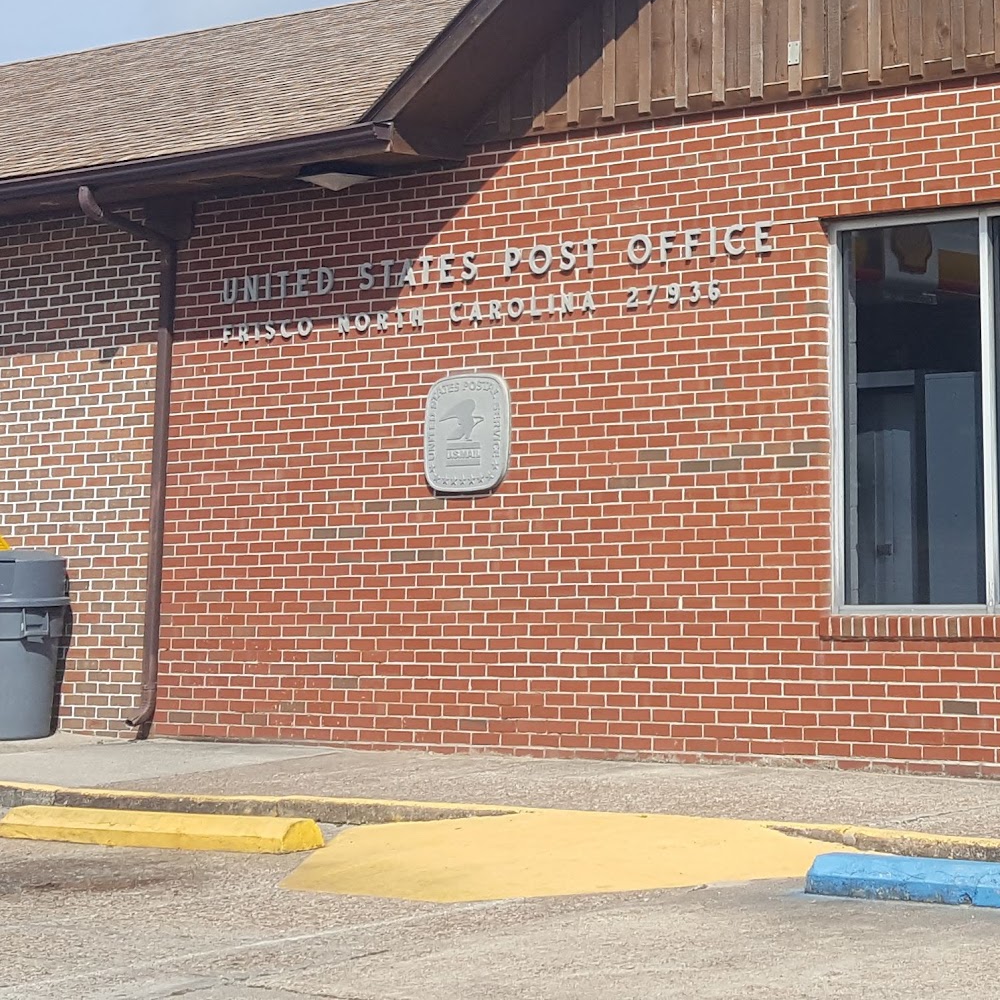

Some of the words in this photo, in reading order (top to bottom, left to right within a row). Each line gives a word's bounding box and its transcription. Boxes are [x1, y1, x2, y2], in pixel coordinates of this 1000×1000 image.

[222, 266, 334, 304] UNITED
[359, 252, 478, 291] STATES
[503, 238, 599, 277] POST
[627, 221, 774, 266] OFFICE
[222, 317, 314, 344] FRISCO
[337, 307, 424, 334] NORTH
[449, 291, 597, 325] CAROLINA
[625, 279, 722, 309] 27936
